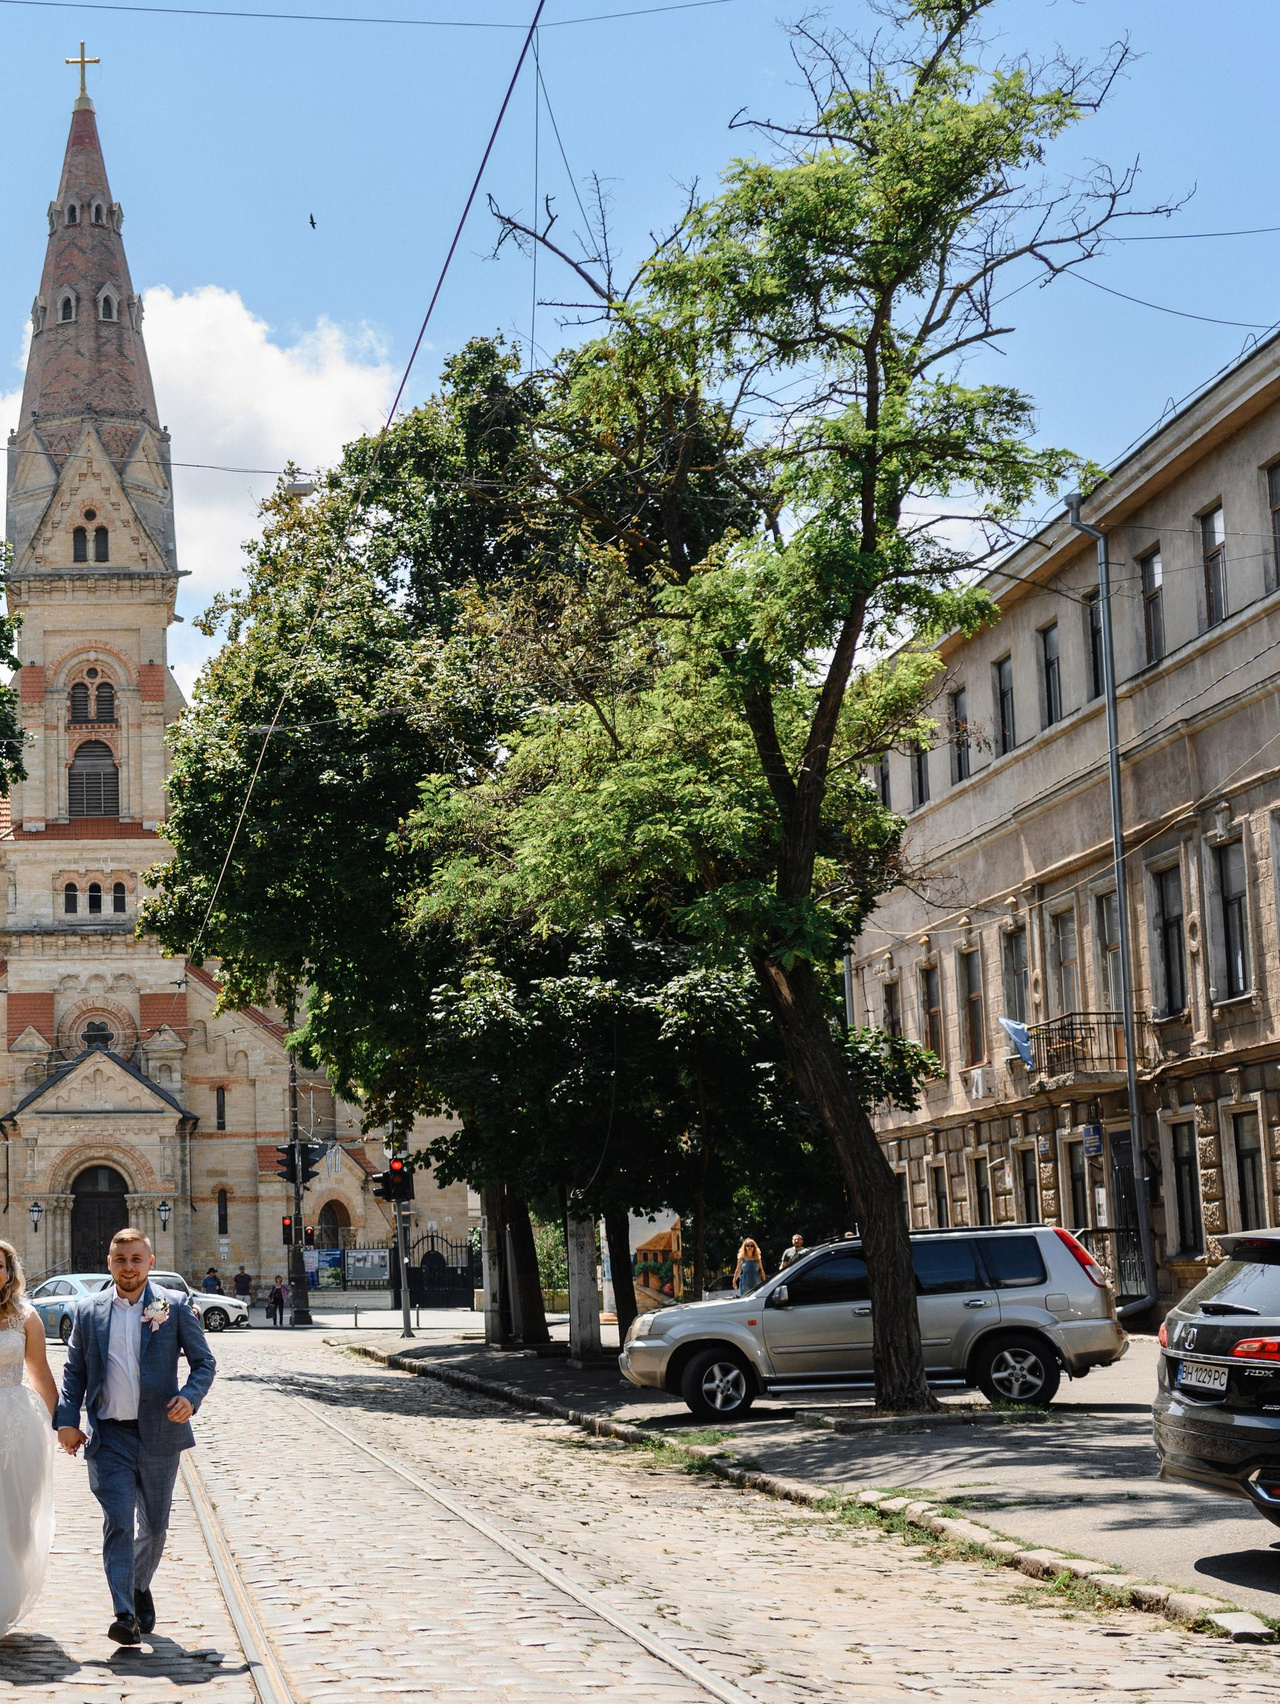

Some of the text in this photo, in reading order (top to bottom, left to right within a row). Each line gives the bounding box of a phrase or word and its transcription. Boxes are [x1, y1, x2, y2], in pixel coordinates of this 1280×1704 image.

[1181, 1365, 1226, 1386] BH 1229 PC
[1244, 1368, 1275, 1378] RDX
